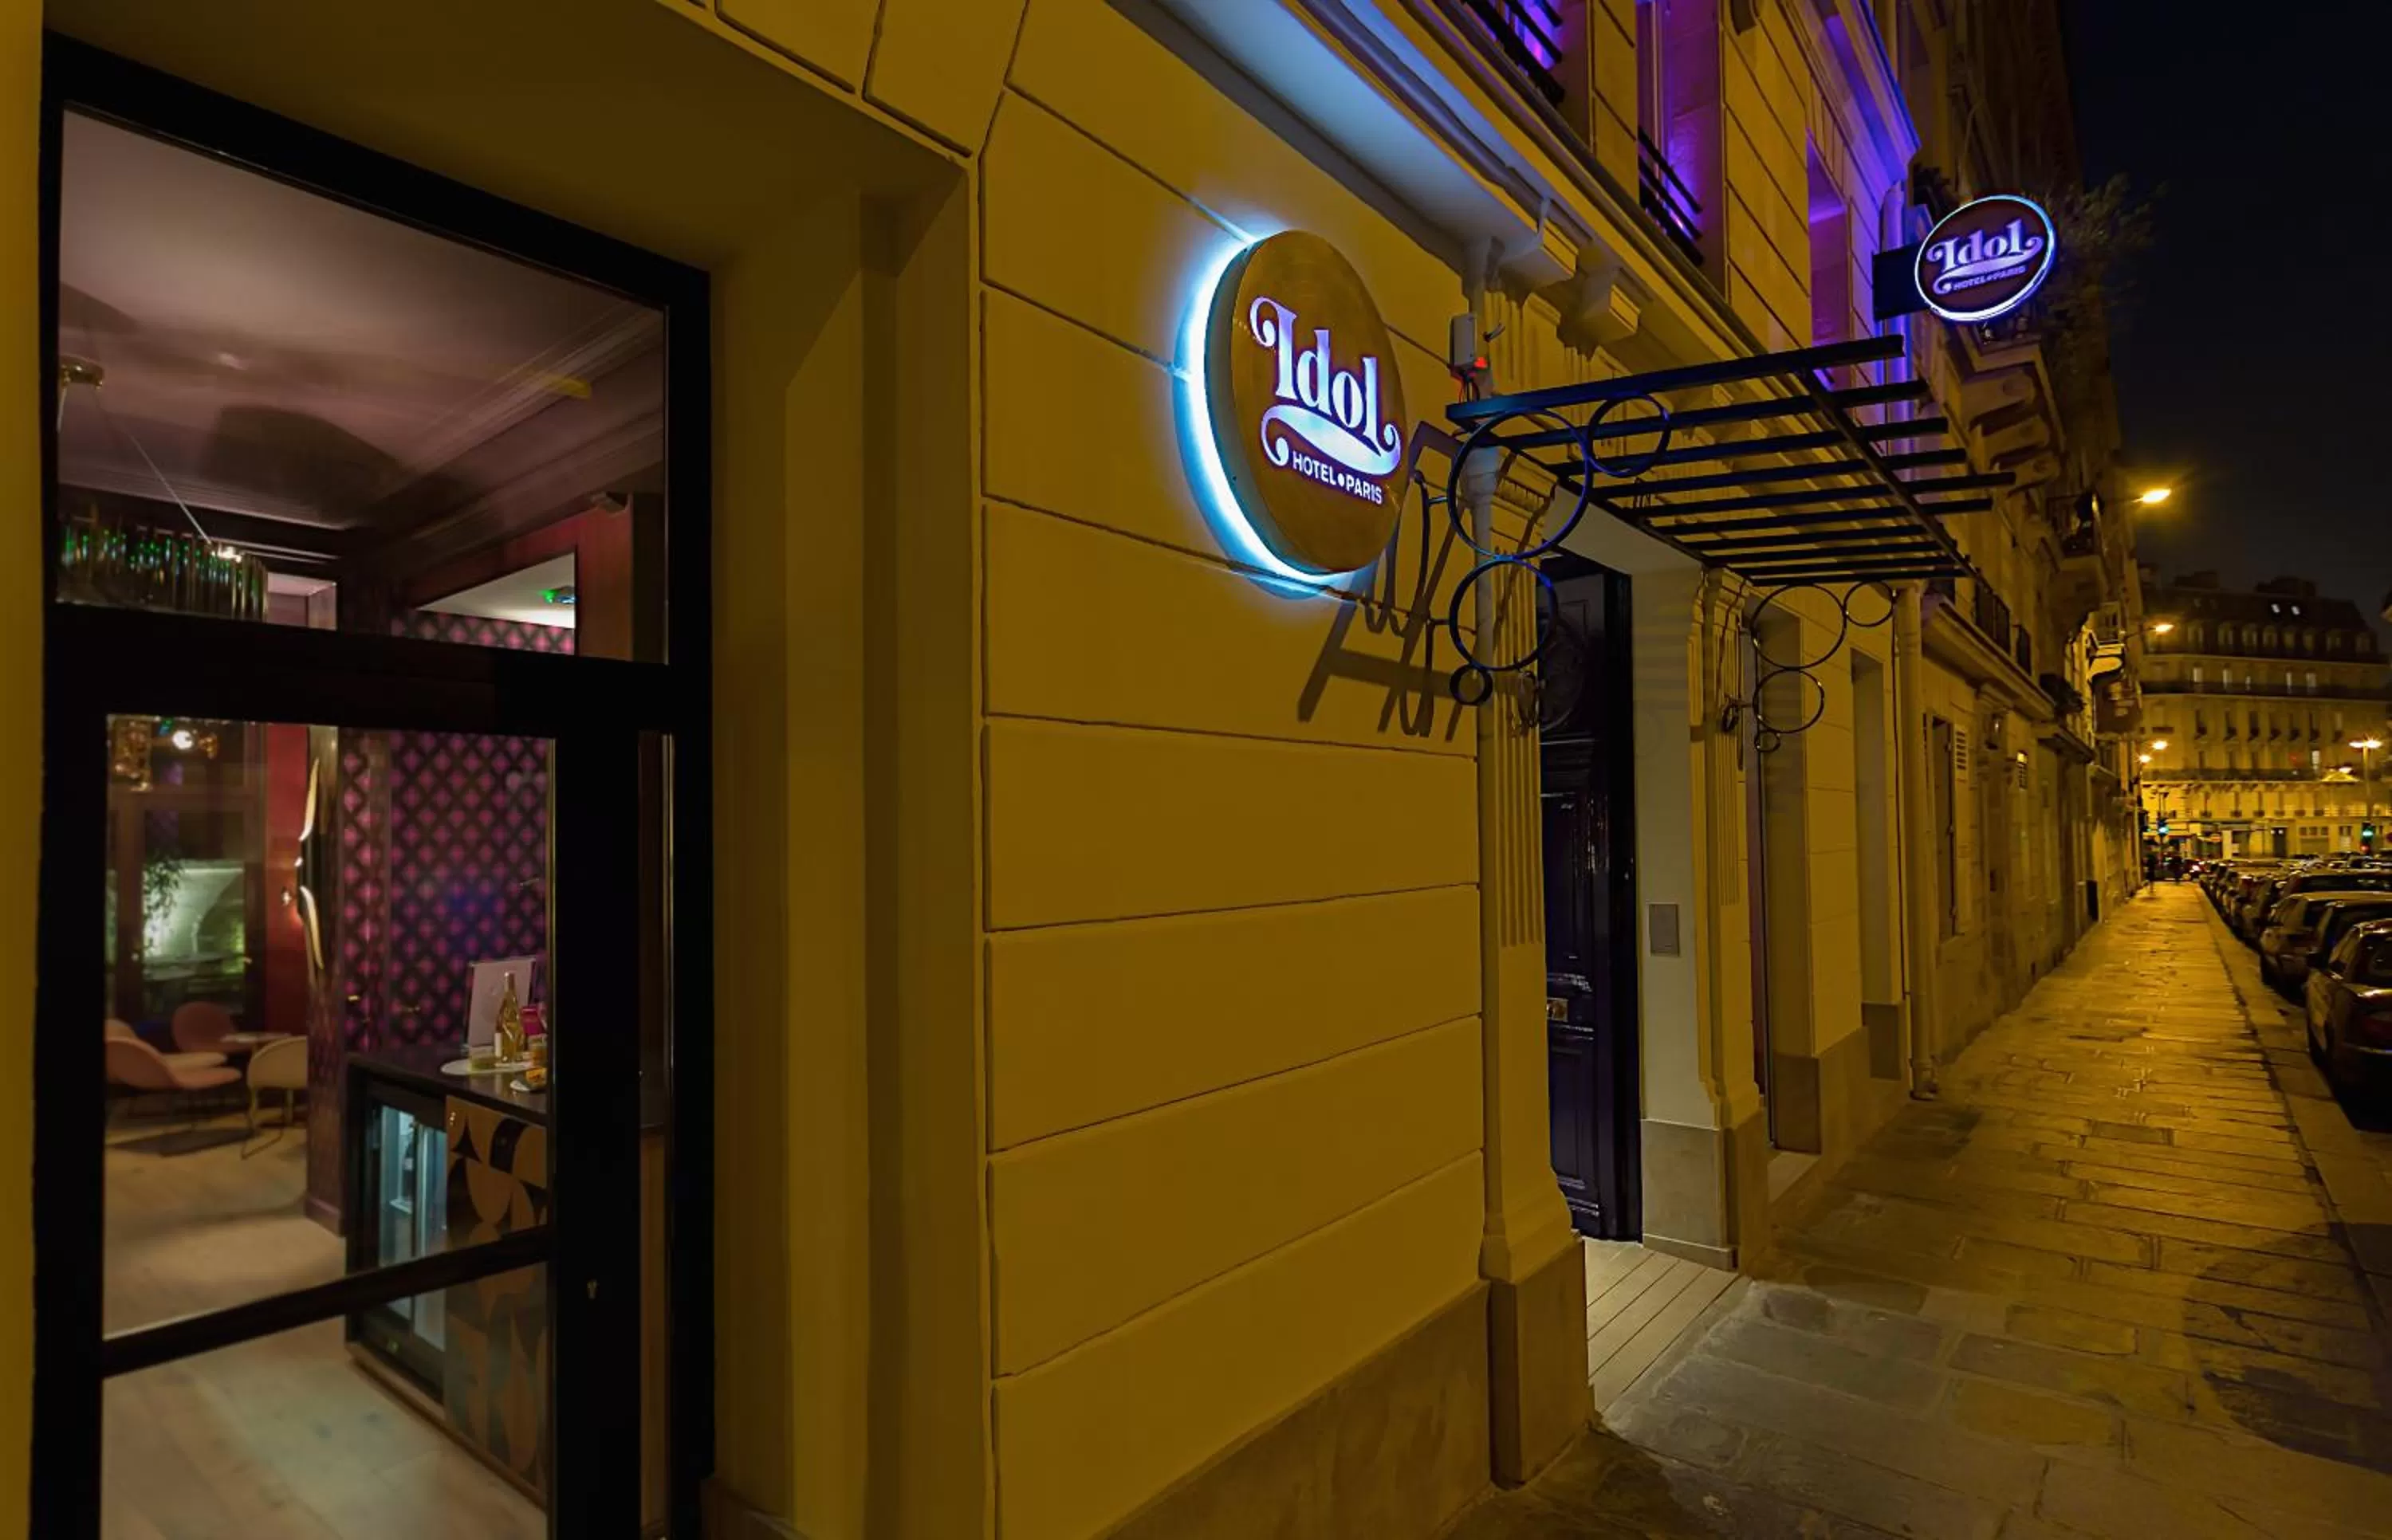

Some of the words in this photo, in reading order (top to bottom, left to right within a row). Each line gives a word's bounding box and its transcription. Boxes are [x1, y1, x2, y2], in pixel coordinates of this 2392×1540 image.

[1926, 219, 2043, 276] Idol
[1249, 296, 1401, 456] Idol
[1292, 451, 1337, 485] HOTEL
[1345, 473, 1383, 505] PARIS
